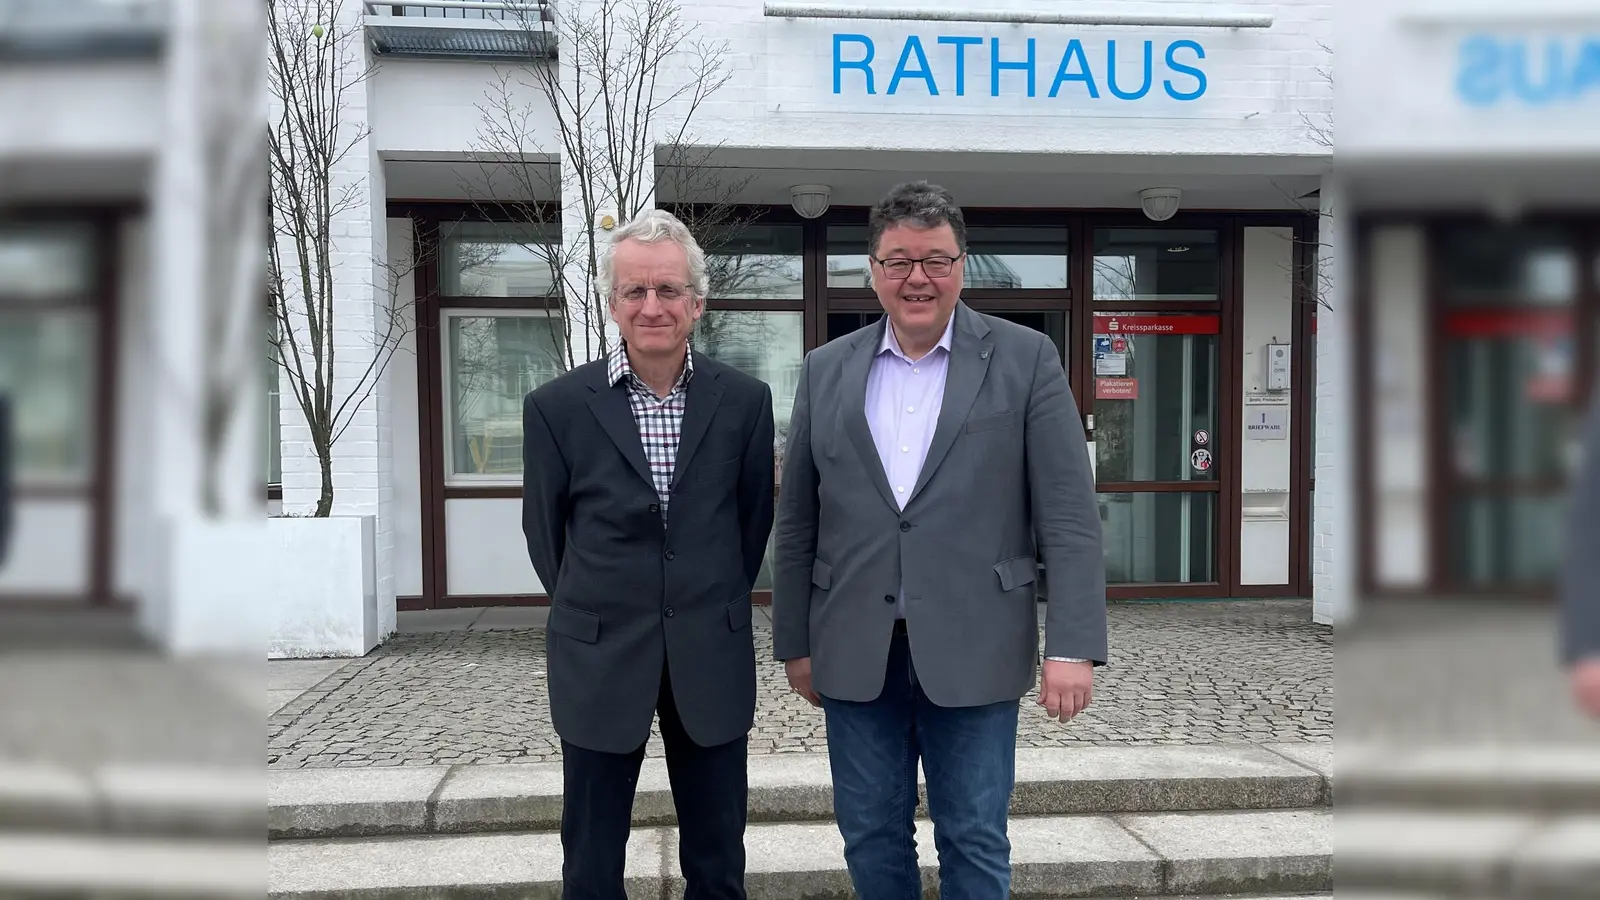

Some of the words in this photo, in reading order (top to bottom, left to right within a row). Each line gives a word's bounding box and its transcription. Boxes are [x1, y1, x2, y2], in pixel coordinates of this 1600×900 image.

[832, 33, 1208, 101] RATHAUS
[1122, 324, 1174, 332] Kreissparkasse
[1100, 380, 1134, 388] Plakatieren
